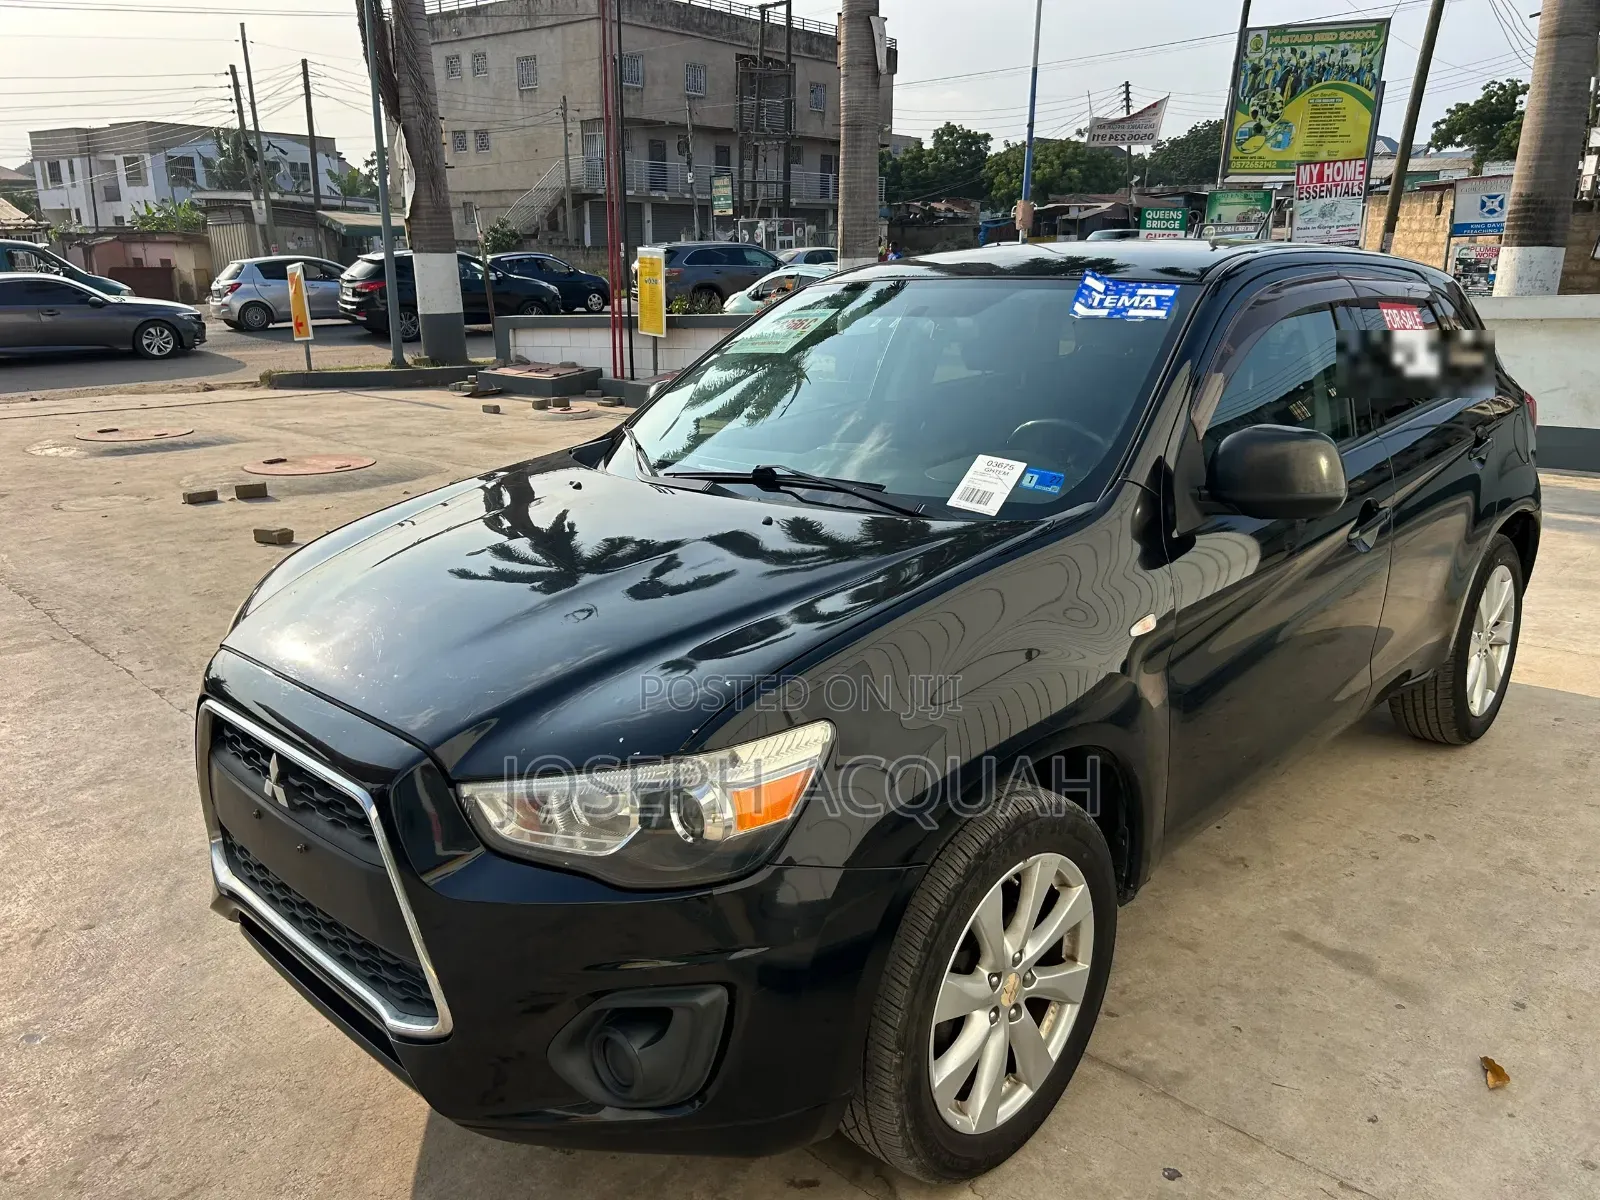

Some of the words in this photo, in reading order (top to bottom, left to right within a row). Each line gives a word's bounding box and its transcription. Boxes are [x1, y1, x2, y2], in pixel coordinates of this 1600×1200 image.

[1269, 33, 1313, 44] MUSTARD
[1314, 32, 1338, 42] SEED
[1339, 30, 1378, 40] SCHOOL
[1299, 164, 1320, 184] MY
[1324, 160, 1364, 182] HOME
[1297, 182, 1363, 201] ESSENTIALS
[1145, 210, 1182, 219] QUEENS
[1146, 220, 1180, 229] BRIDGE
[1091, 291, 1157, 307] TEMA
[1382, 309, 1402, 329] FOR
[1400, 310, 1424, 330] SALE
[986, 460, 1016, 471] 03675
[984, 467, 1010, 477] GHTEM
[1027, 475, 1034, 484] 1
